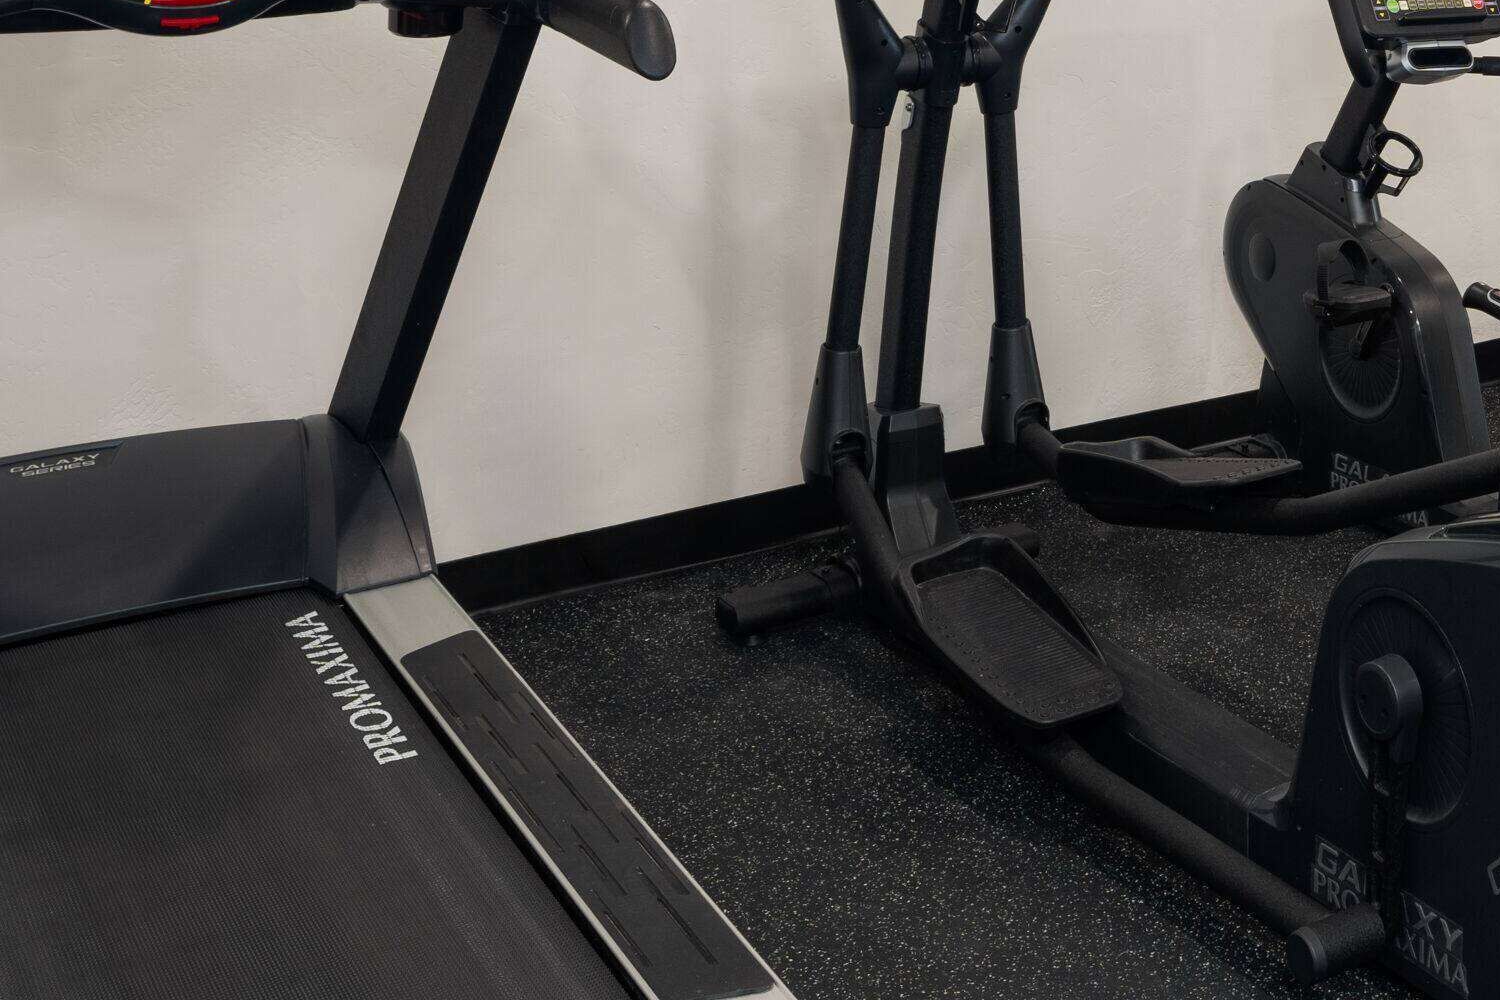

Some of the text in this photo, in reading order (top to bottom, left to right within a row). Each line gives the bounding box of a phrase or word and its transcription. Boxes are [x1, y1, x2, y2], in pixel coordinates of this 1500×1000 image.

[9, 452, 100, 474] GALAXY
[22, 460, 96, 477] SERIES
[285, 610, 418, 766] PROMAXIMA
